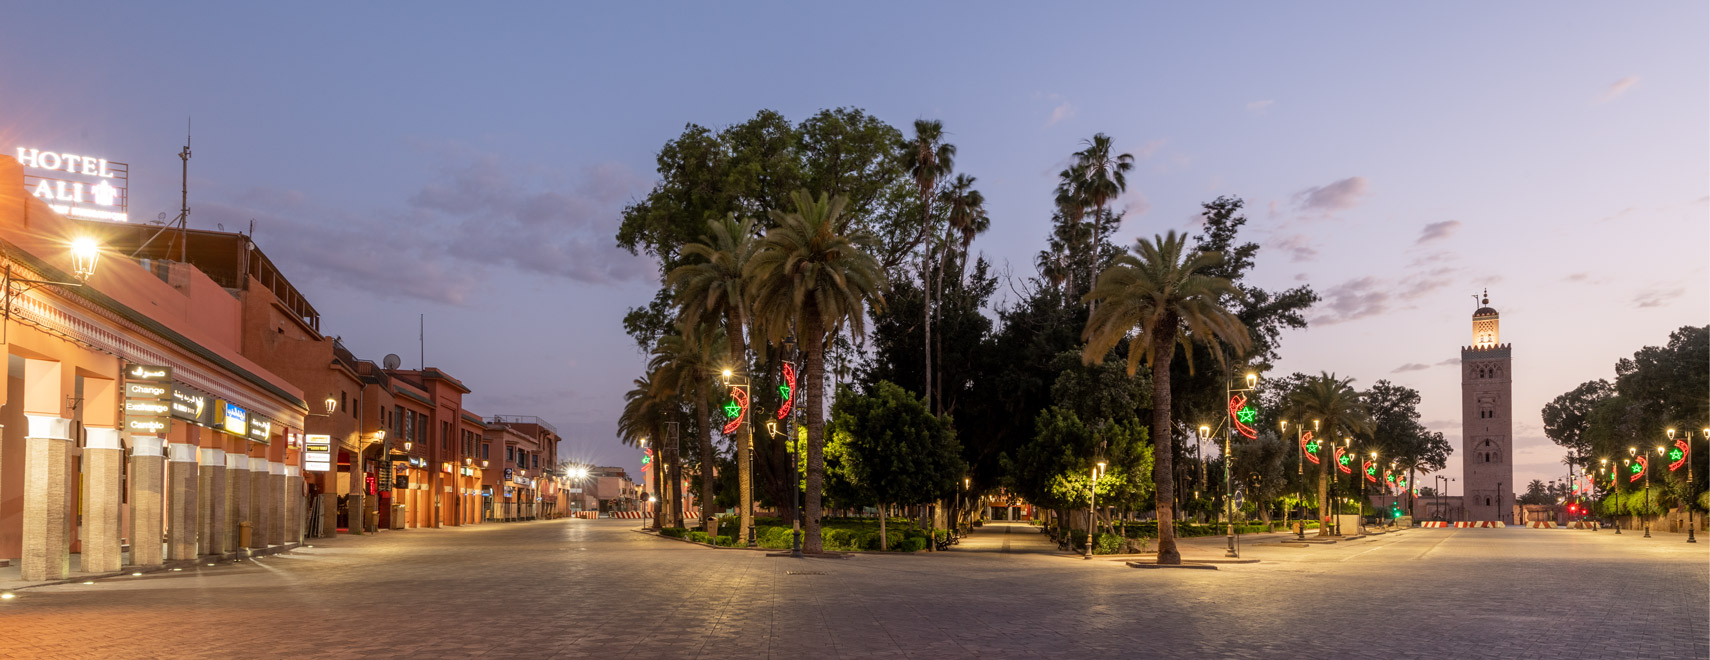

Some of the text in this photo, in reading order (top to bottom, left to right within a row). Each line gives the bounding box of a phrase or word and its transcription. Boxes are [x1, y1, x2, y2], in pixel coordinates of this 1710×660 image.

[17, 147, 114, 178] HOTEL
[33, 179, 83, 202] ALI
[131, 385, 165, 395] Change
[126, 403, 169, 413] Exchange
[130, 420, 165, 429] Cambio
